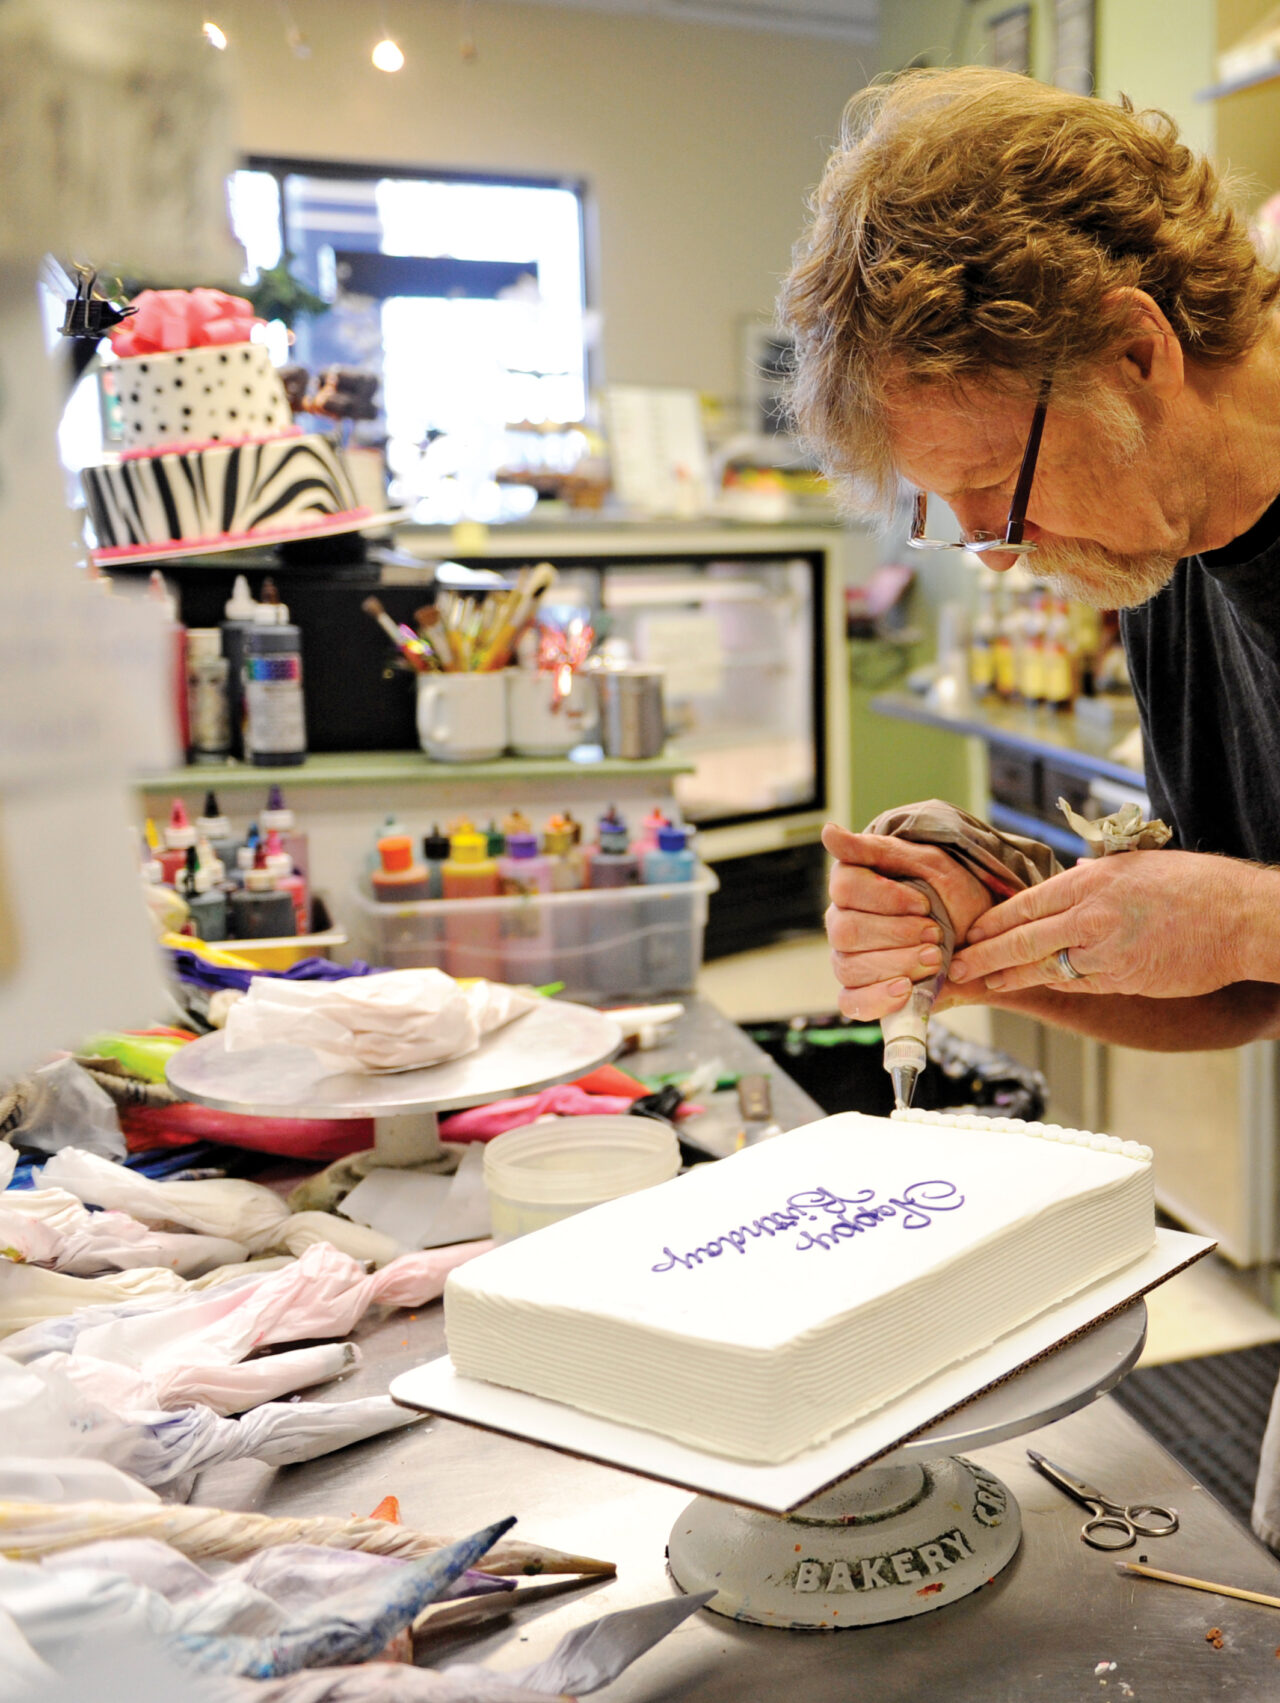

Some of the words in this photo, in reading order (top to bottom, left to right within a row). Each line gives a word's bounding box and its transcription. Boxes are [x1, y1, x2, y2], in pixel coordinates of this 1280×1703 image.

[652, 1187, 875, 1272] Birthday
[796, 1180, 964, 1250] Happy
[795, 1531, 975, 1592] BAKERY
